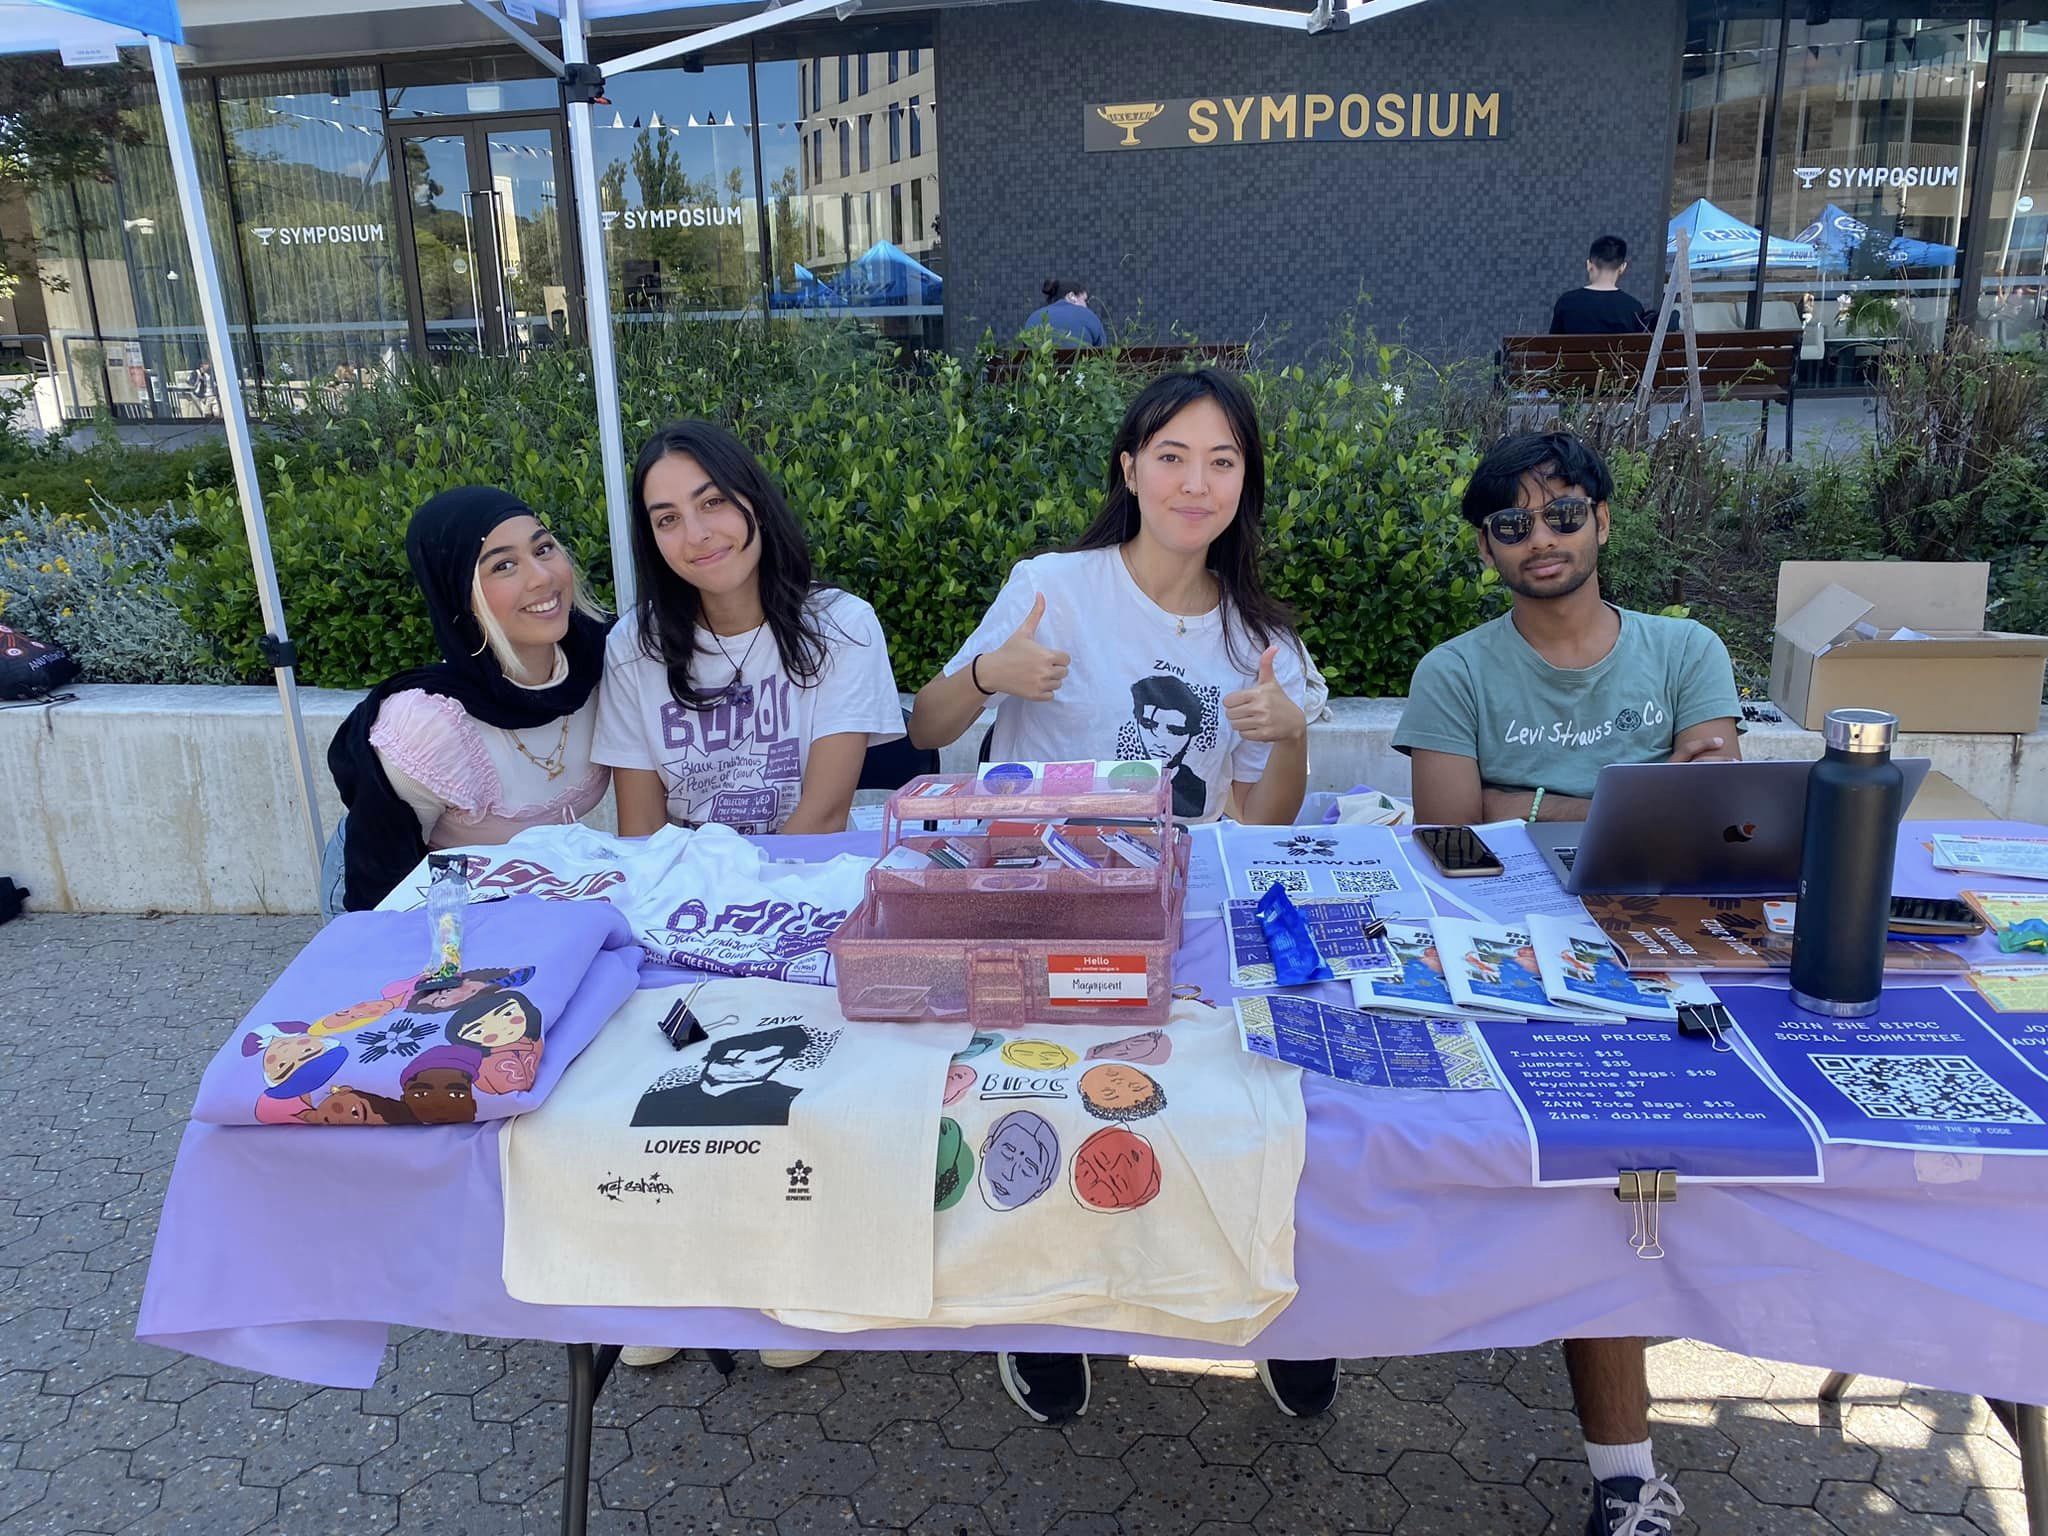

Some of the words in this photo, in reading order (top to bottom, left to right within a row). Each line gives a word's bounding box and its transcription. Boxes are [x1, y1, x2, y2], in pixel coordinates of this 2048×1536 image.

[1187, 93, 1500, 144] SYMPOSIUM
[1828, 166, 1959, 189] SYMPOSIUM
[624, 206, 743, 230] SYMPOSIUM
[279, 223, 384, 245] SYMPOSIUM
[1153, 659, 1186, 678] ZAYN
[660, 674, 791, 753] BIPOC
[1505, 719, 1544, 745] Levi
[1548, 719, 1612, 746] Strauss
[1642, 700, 1663, 726] Co
[681, 761, 713, 777] Black
[1348, 858, 1382, 866] US!
[1083, 956, 1110, 966] Hello
[756, 1015, 803, 1027] ZAYN
[1778, 1021, 1824, 1030] JOIN
[1832, 1021, 1871, 1030] THE
[1878, 1021, 1941, 1030] BIPOC
[2023, 1024, 2048, 1033] JO
[1532, 1033, 1592, 1042] MERCH
[1600, 1033, 1672, 1042] PRICES
[1774, 1032, 1847, 1043] SOCIAL
[1855, 1033, 1966, 1043] COMMITTEE
[2012, 1037, 2048, 1047] ADV
[1509, 1050, 1585, 1058] T-shirt:
[1594, 1049, 1624, 1058] $15
[1517, 1060, 1592, 1069] Jumpers:
[1521, 1070, 1572, 1078] BIPOC
[1579, 1070, 1620, 1078] Tote
[1628, 1070, 1677, 1079] Bags:
[1685, 1069, 1718, 1077] $10
[981, 1073, 1069, 1092] BIPOC
[1535, 1090, 1604, 1098] Prints:
[1613, 1090, 1636, 1098] $5
[1541, 1100, 1584, 1108] ZAYN
[1591, 1100, 1635, 1108] Tote
[1641, 1100, 1693, 1109] Bags:
[1548, 1111, 1599, 1120] Zine:
[1611, 1111, 1672, 1120] dollar
[1682, 1111, 1767, 1120] donation
[1944, 1125, 1965, 1133] THE
[1986, 1126, 2013, 1136] CODE
[643, 1139, 701, 1154] LOVES
[705, 1139, 762, 1154] BIPOC
